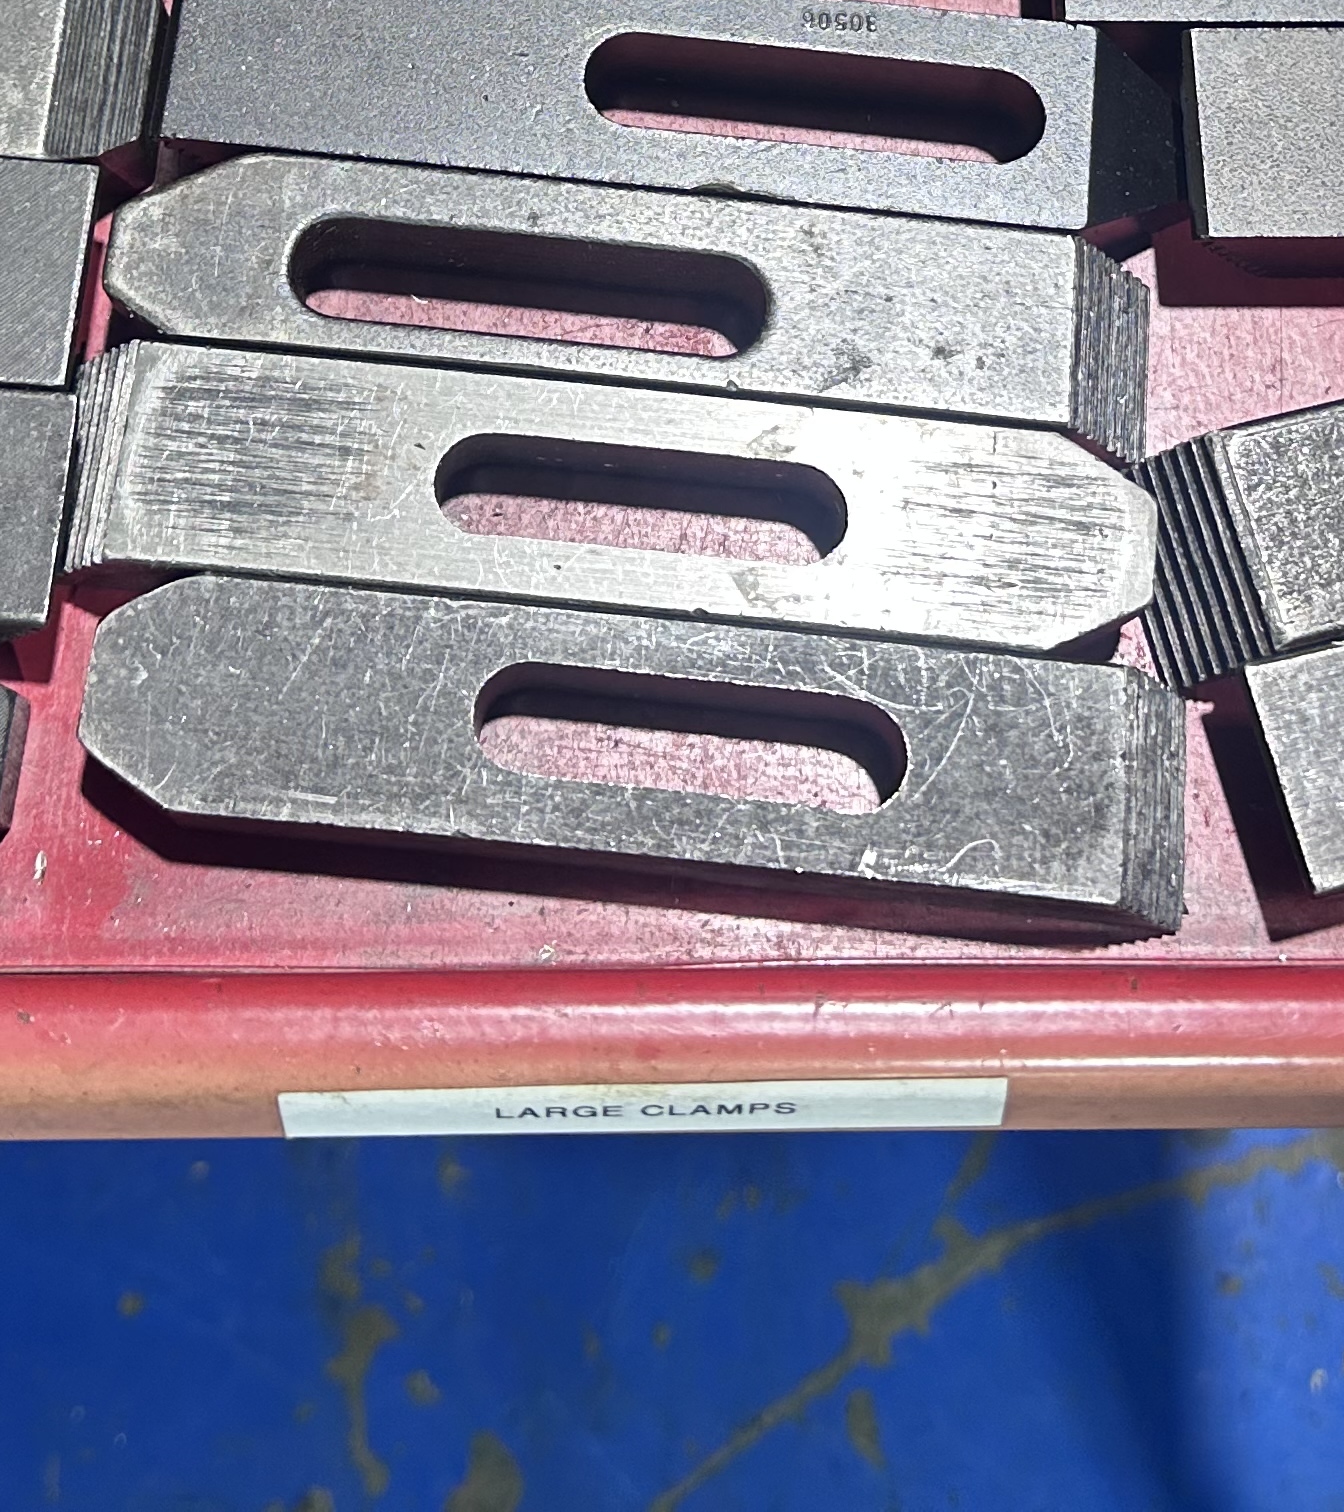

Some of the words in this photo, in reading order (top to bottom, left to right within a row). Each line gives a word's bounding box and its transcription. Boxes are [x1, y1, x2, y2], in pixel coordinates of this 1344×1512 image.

[801, 8, 878, 33] 30506
[495, 1104, 625, 1120] LARGE
[640, 1101, 798, 1117] CLAMPS
